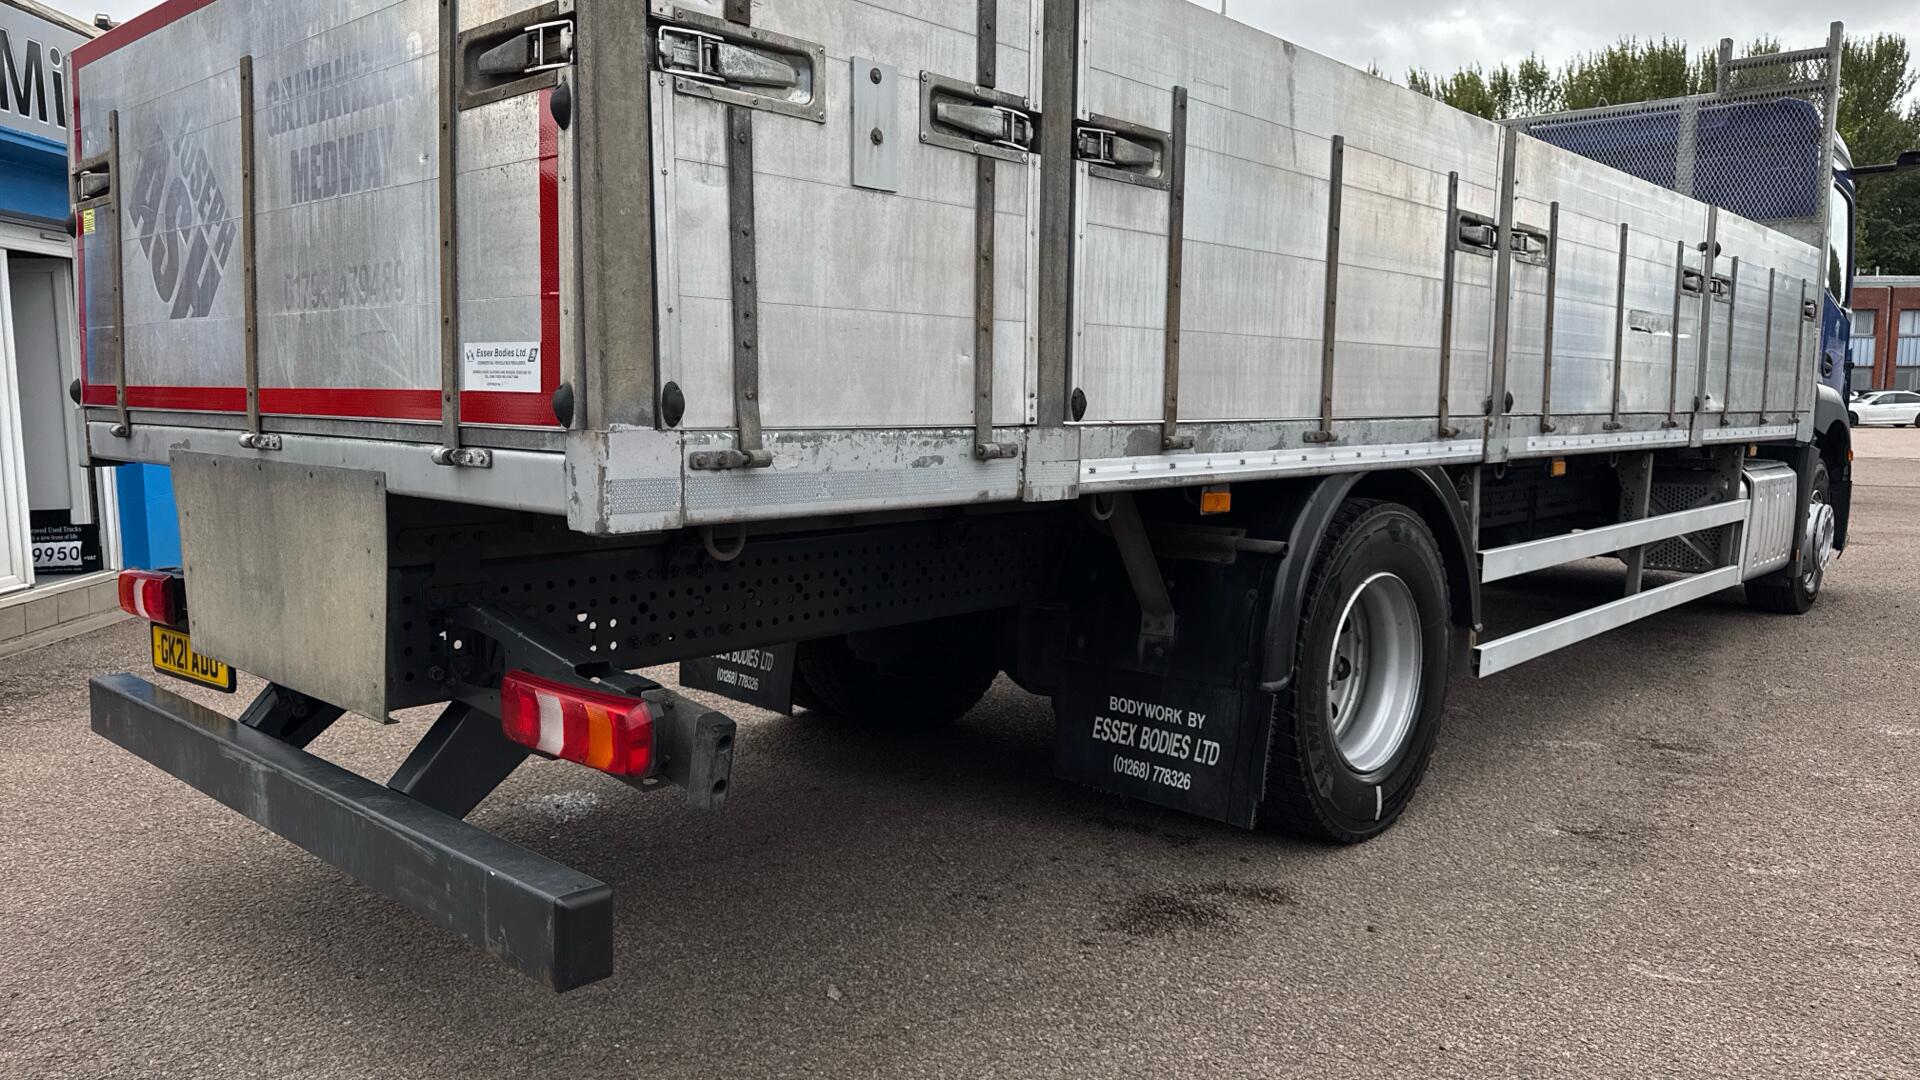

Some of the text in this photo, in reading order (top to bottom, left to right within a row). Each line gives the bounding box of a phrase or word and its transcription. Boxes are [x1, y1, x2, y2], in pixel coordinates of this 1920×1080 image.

[290, 126, 396, 204] MEDWAY
[283, 268, 329, 310] 0179
[476, 348, 493, 358] Essex
[494, 348, 515, 358] Bodies
[161, 633, 188, 671] GK21
[731, 649, 760, 668] BODIES
[760, 651, 774, 671] LTD
[1109, 695, 1206, 729] BODYWORK BY
[1092, 716, 1220, 766] ESSEX BODIES LTD
[1113, 754, 1192, 790] (01268) 778326
